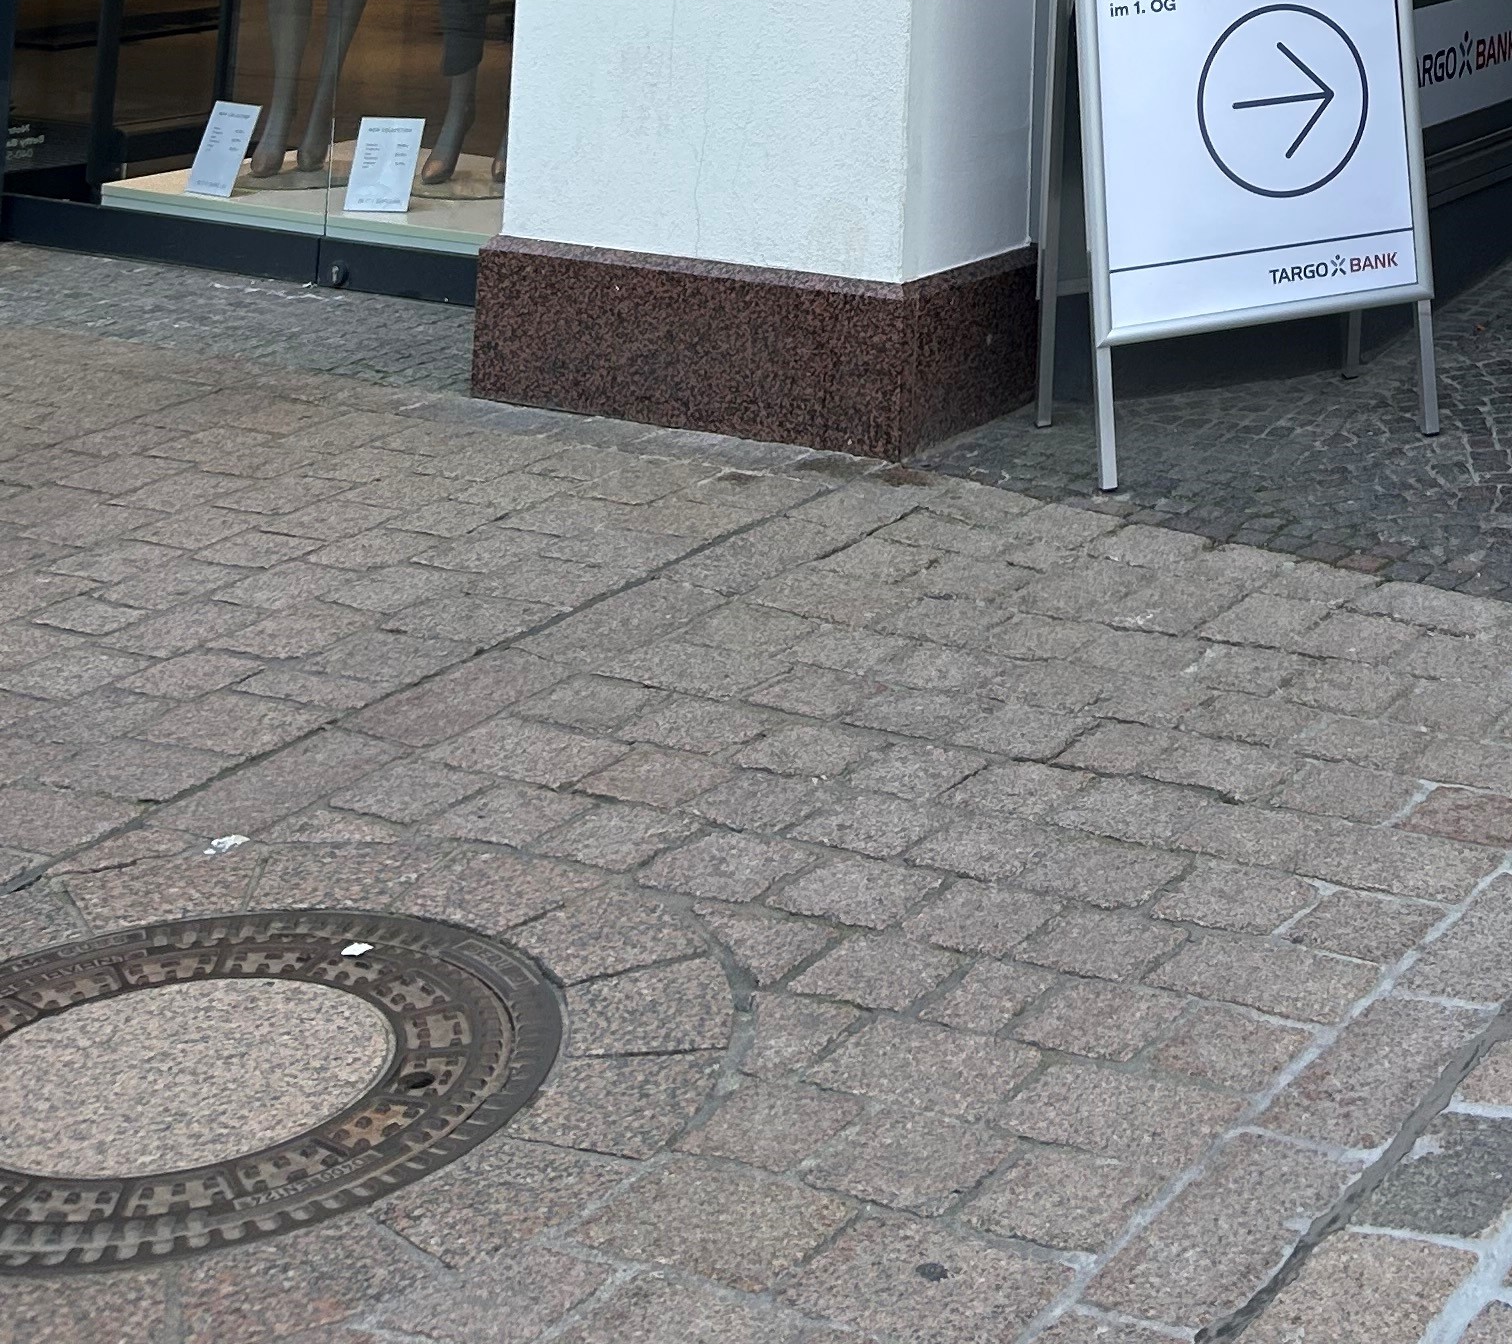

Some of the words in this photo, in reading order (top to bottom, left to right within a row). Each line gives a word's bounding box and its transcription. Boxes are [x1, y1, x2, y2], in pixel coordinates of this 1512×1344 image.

[1109, 3, 1129, 18] im
[1133, 0, 1146, 15] 1.
[1269, 261, 1329, 285] TARGO
[1349, 251, 1399, 273] BANK
